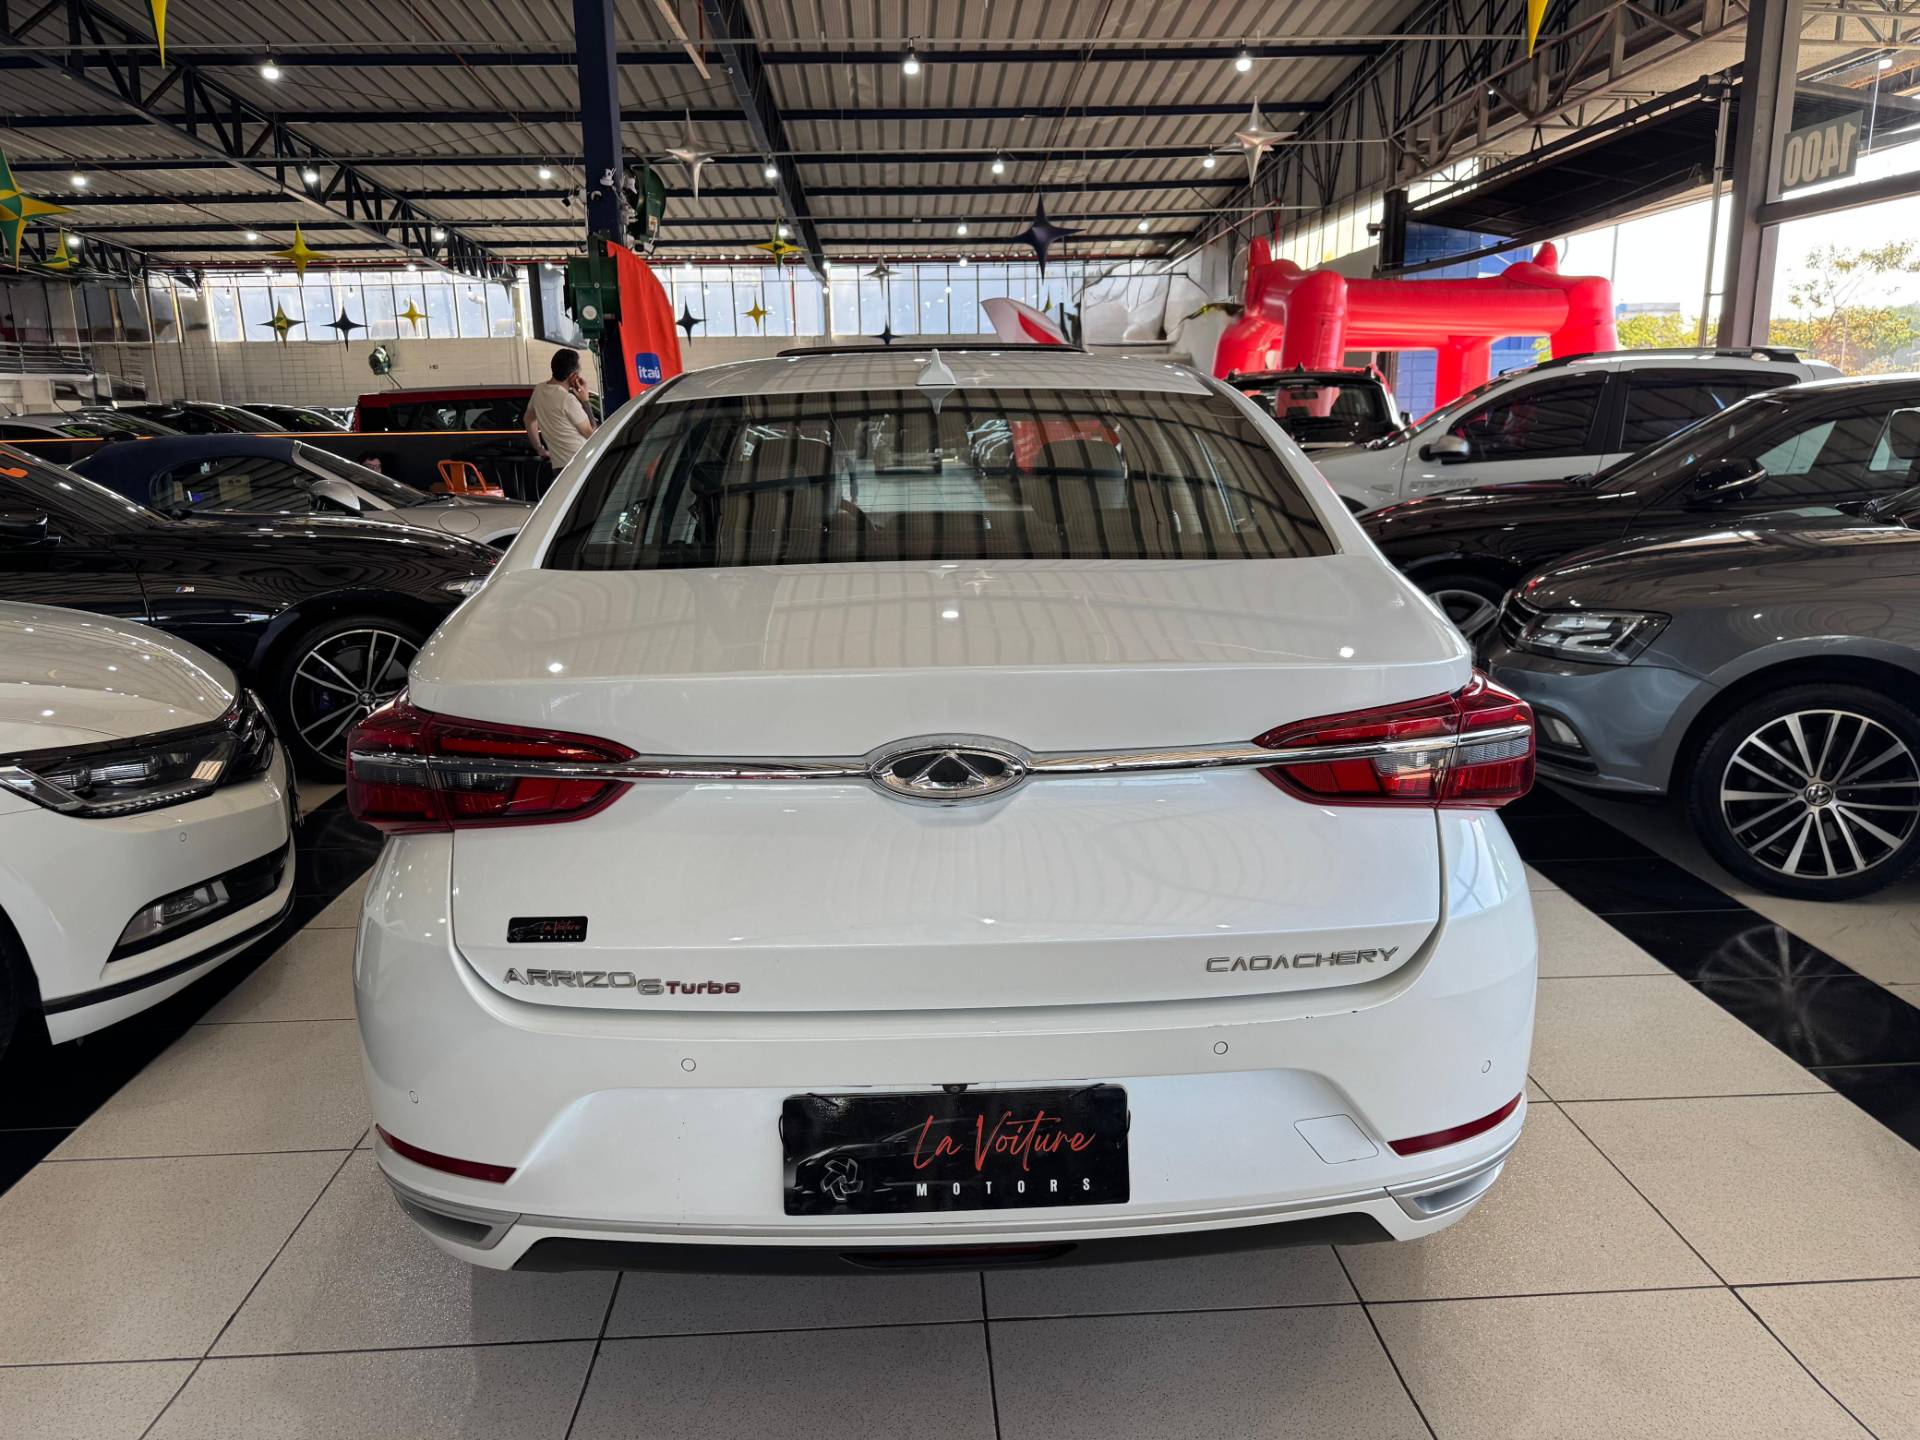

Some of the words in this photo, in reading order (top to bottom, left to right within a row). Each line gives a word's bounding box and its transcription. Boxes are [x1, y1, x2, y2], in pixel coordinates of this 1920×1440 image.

[665, 980, 741, 995] Turbo
[913, 1114, 963, 1170] La
[974, 1109, 1096, 1172] Voiture
[916, 1177, 1091, 1197] MOTORS
